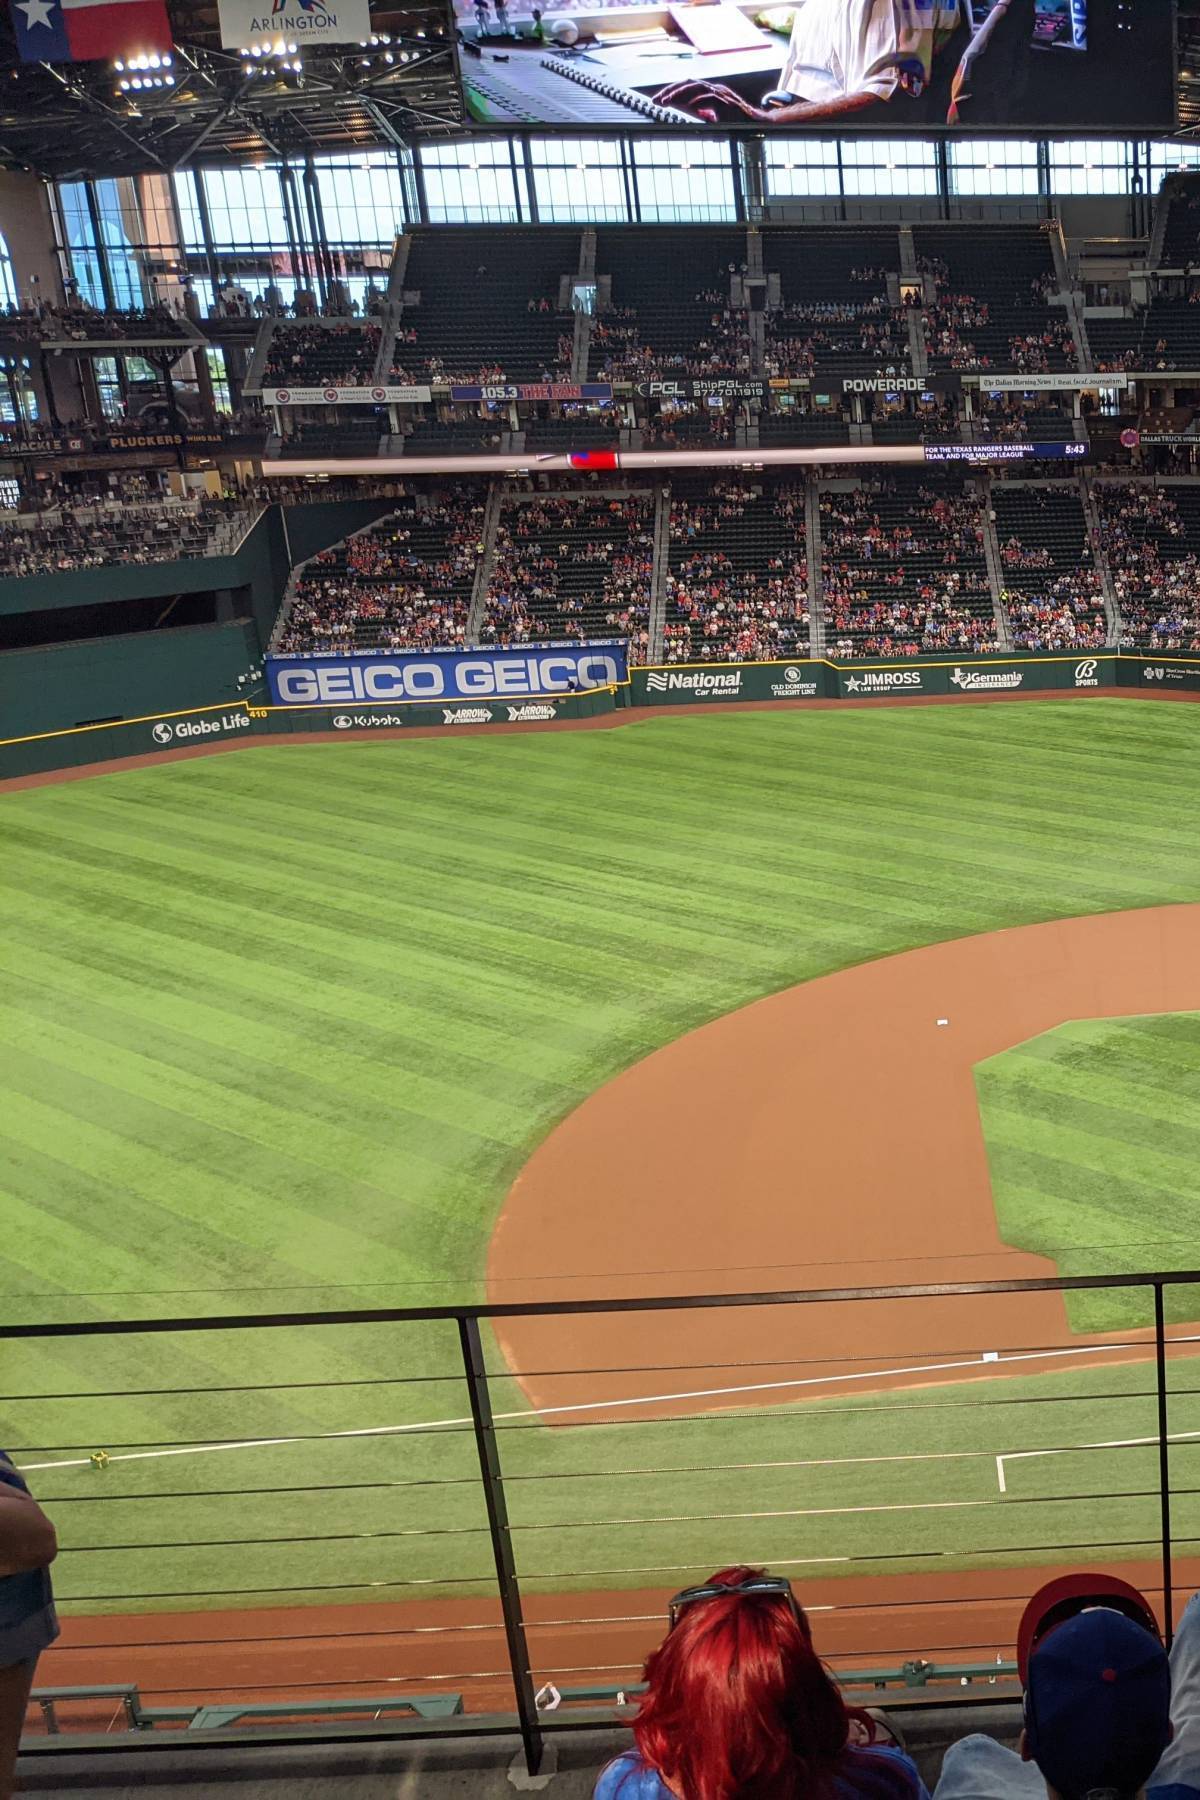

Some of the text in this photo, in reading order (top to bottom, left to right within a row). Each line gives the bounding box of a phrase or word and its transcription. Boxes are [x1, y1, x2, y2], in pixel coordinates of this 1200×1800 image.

[250, 14, 338, 32] ARLINGTON
[650, 381, 686, 395] PGL
[692, 380, 763, 390] ShipPGL.com
[842, 378, 927, 392] POWERADE
[481, 386, 518, 399] 105.3
[520, 384, 549, 400] THE
[693, 388, 763, 397] 877.701.1919
[110, 435, 182, 448] PLUCKERS
[1065, 445, 1084, 454] 5:43
[277, 656, 617, 702] GEICO GEICO
[971, 671, 1023, 682] Germania
[695, 687, 739, 696] Car Rental
[249, 710, 267, 718] 410
[455, 709, 488, 718] ARROW
[519, 705, 552, 715] ARROW
[175, 713, 250, 738] Globe Life
[354, 714, 402, 726] Kubota
